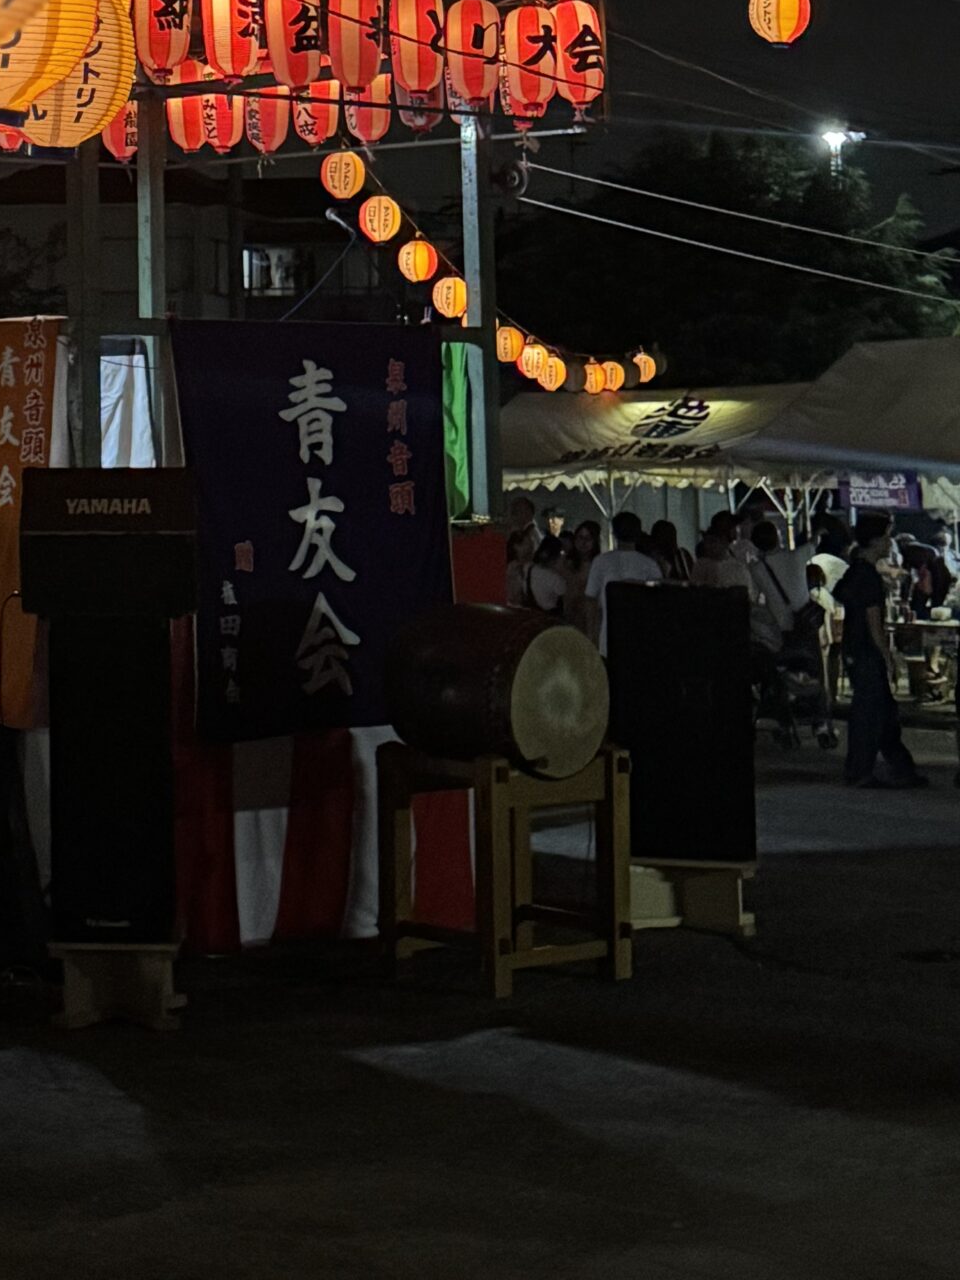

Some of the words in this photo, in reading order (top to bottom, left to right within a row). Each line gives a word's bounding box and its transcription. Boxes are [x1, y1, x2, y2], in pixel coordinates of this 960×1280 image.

[21, 317, 46, 465] 泉州音頭
[66, 498, 152, 515] YAMAHA
[278, 359, 361, 696] 青友会
